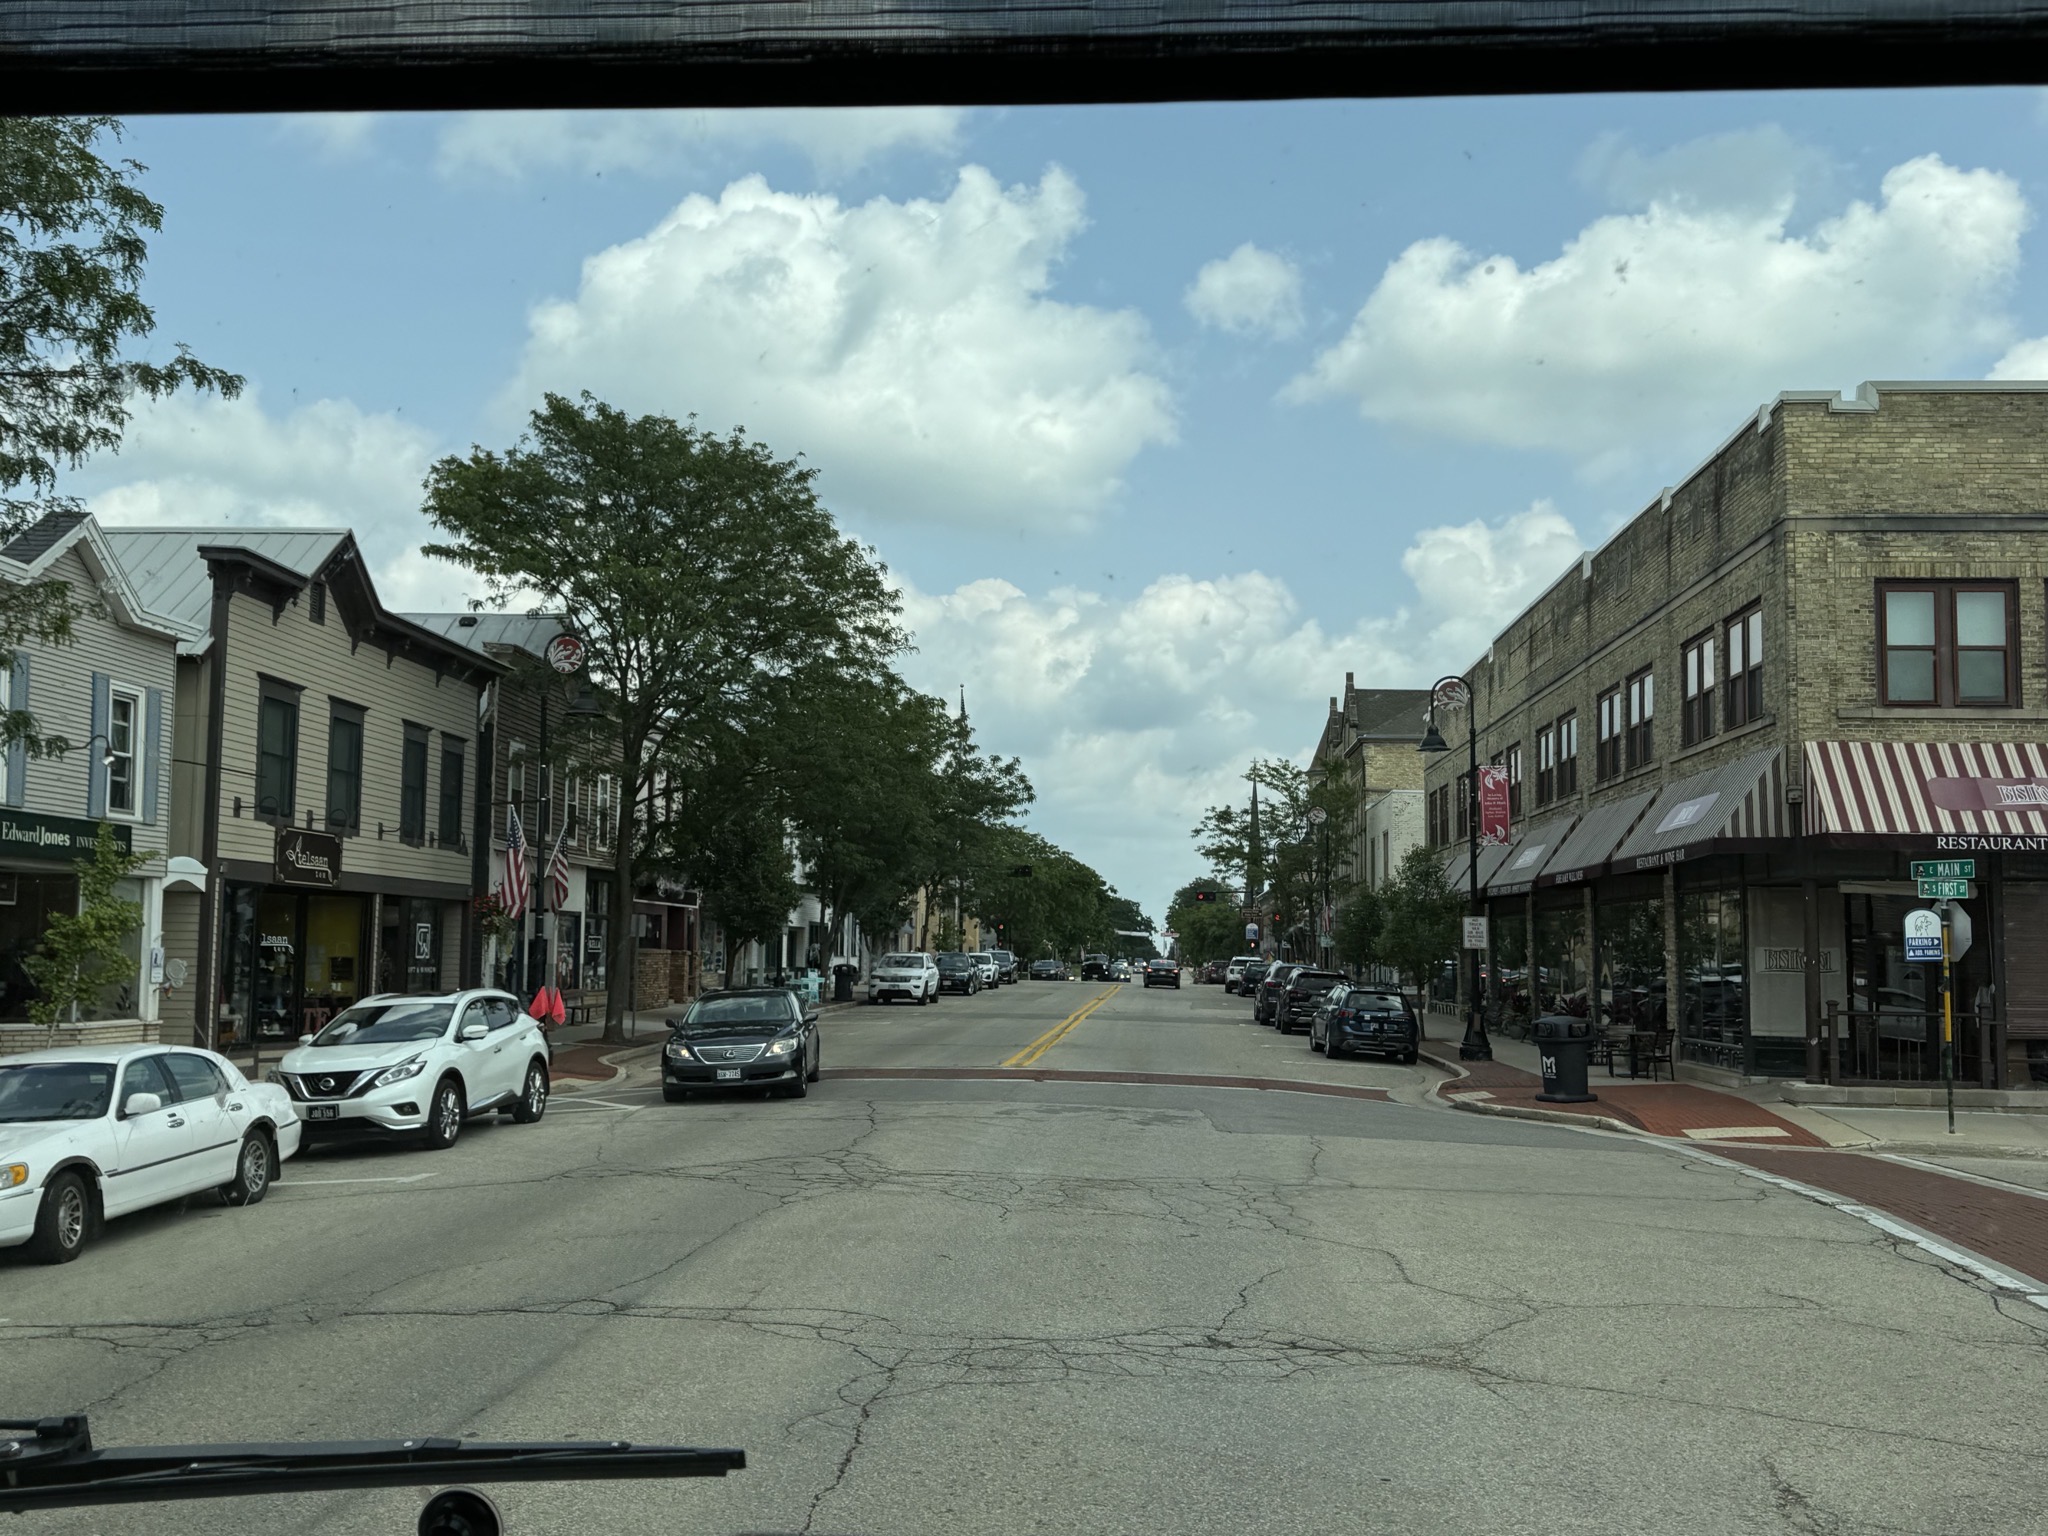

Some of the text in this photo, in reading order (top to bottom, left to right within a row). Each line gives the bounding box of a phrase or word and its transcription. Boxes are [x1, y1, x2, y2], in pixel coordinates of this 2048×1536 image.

[1936, 835, 2048, 851] RESTAURANT
[297, 851, 329, 868] telsaan
[1636, 854, 1660, 869] RESTAURANT
[1937, 863, 1960, 877] MAIN
[1964, 865, 1971, 873] ST
[1938, 882, 1958, 896] FIRST
[1908, 938, 1932, 947] PARKING
[303, 1007, 343, 1033] TE
